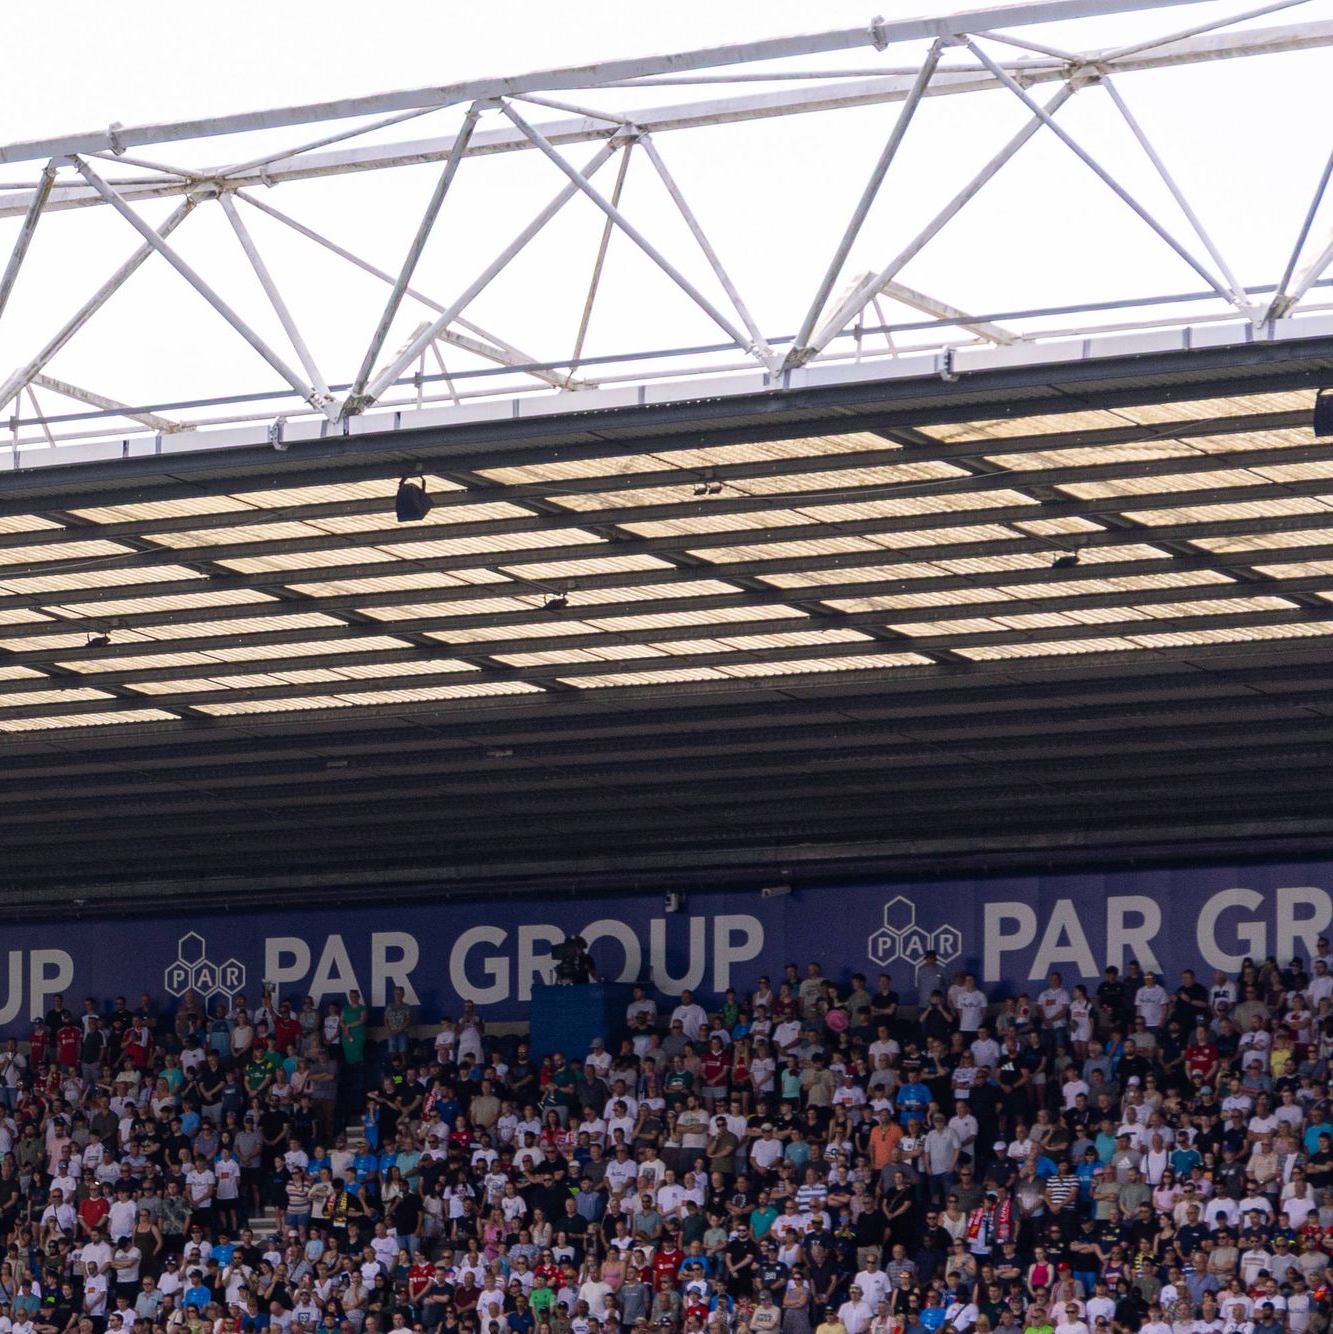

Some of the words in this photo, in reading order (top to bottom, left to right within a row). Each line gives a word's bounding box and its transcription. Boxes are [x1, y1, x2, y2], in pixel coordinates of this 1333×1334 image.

[264, 929, 420, 1010] PAR
[449, 913, 765, 1006] GROUP
[983, 895, 1164, 983] PAR
